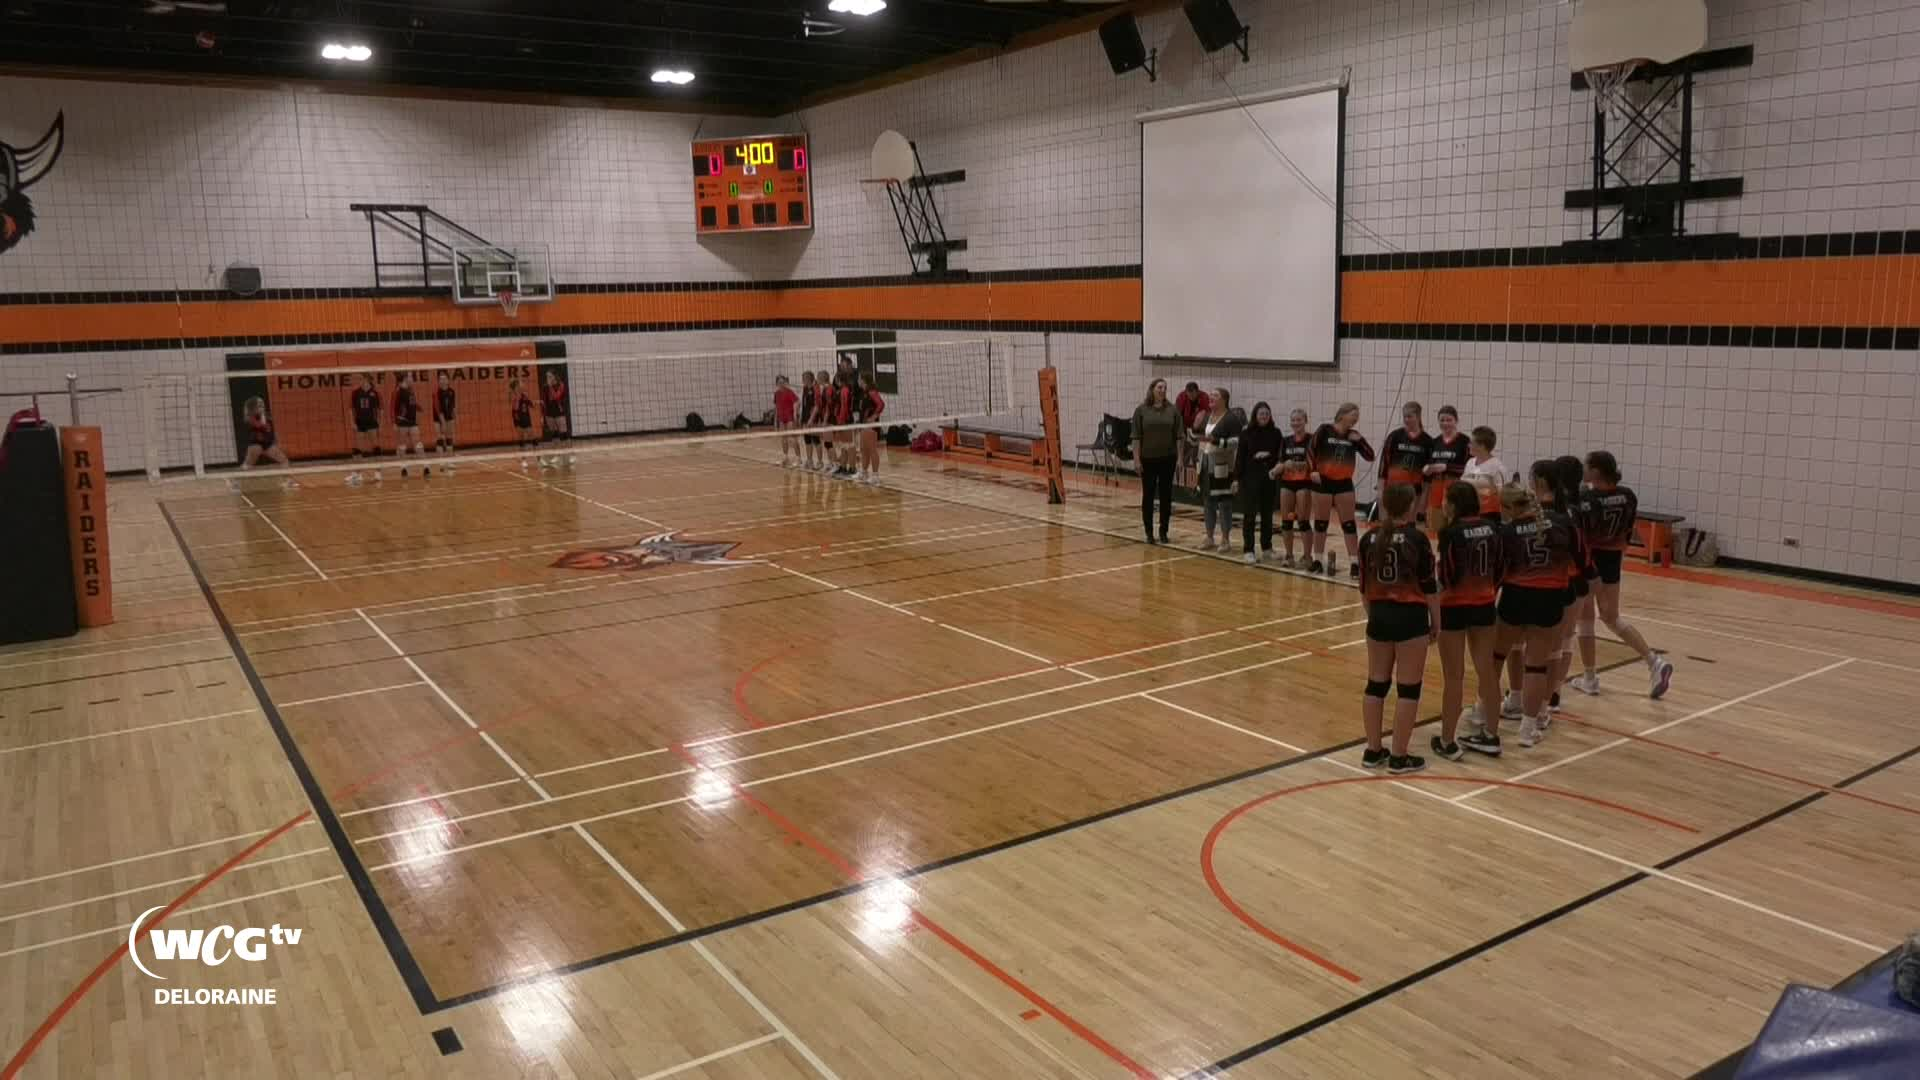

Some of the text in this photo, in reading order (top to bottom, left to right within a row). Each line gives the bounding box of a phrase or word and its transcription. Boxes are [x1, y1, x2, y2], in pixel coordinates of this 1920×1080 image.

[709, 153, 722, 176] 0
[794, 148, 806, 171] 0
[277, 373, 352, 390] HOME
[73, 450, 100, 597] RAIDERS
[1603, 507, 1625, 538] 7
[1526, 533, 1552, 567] 5
